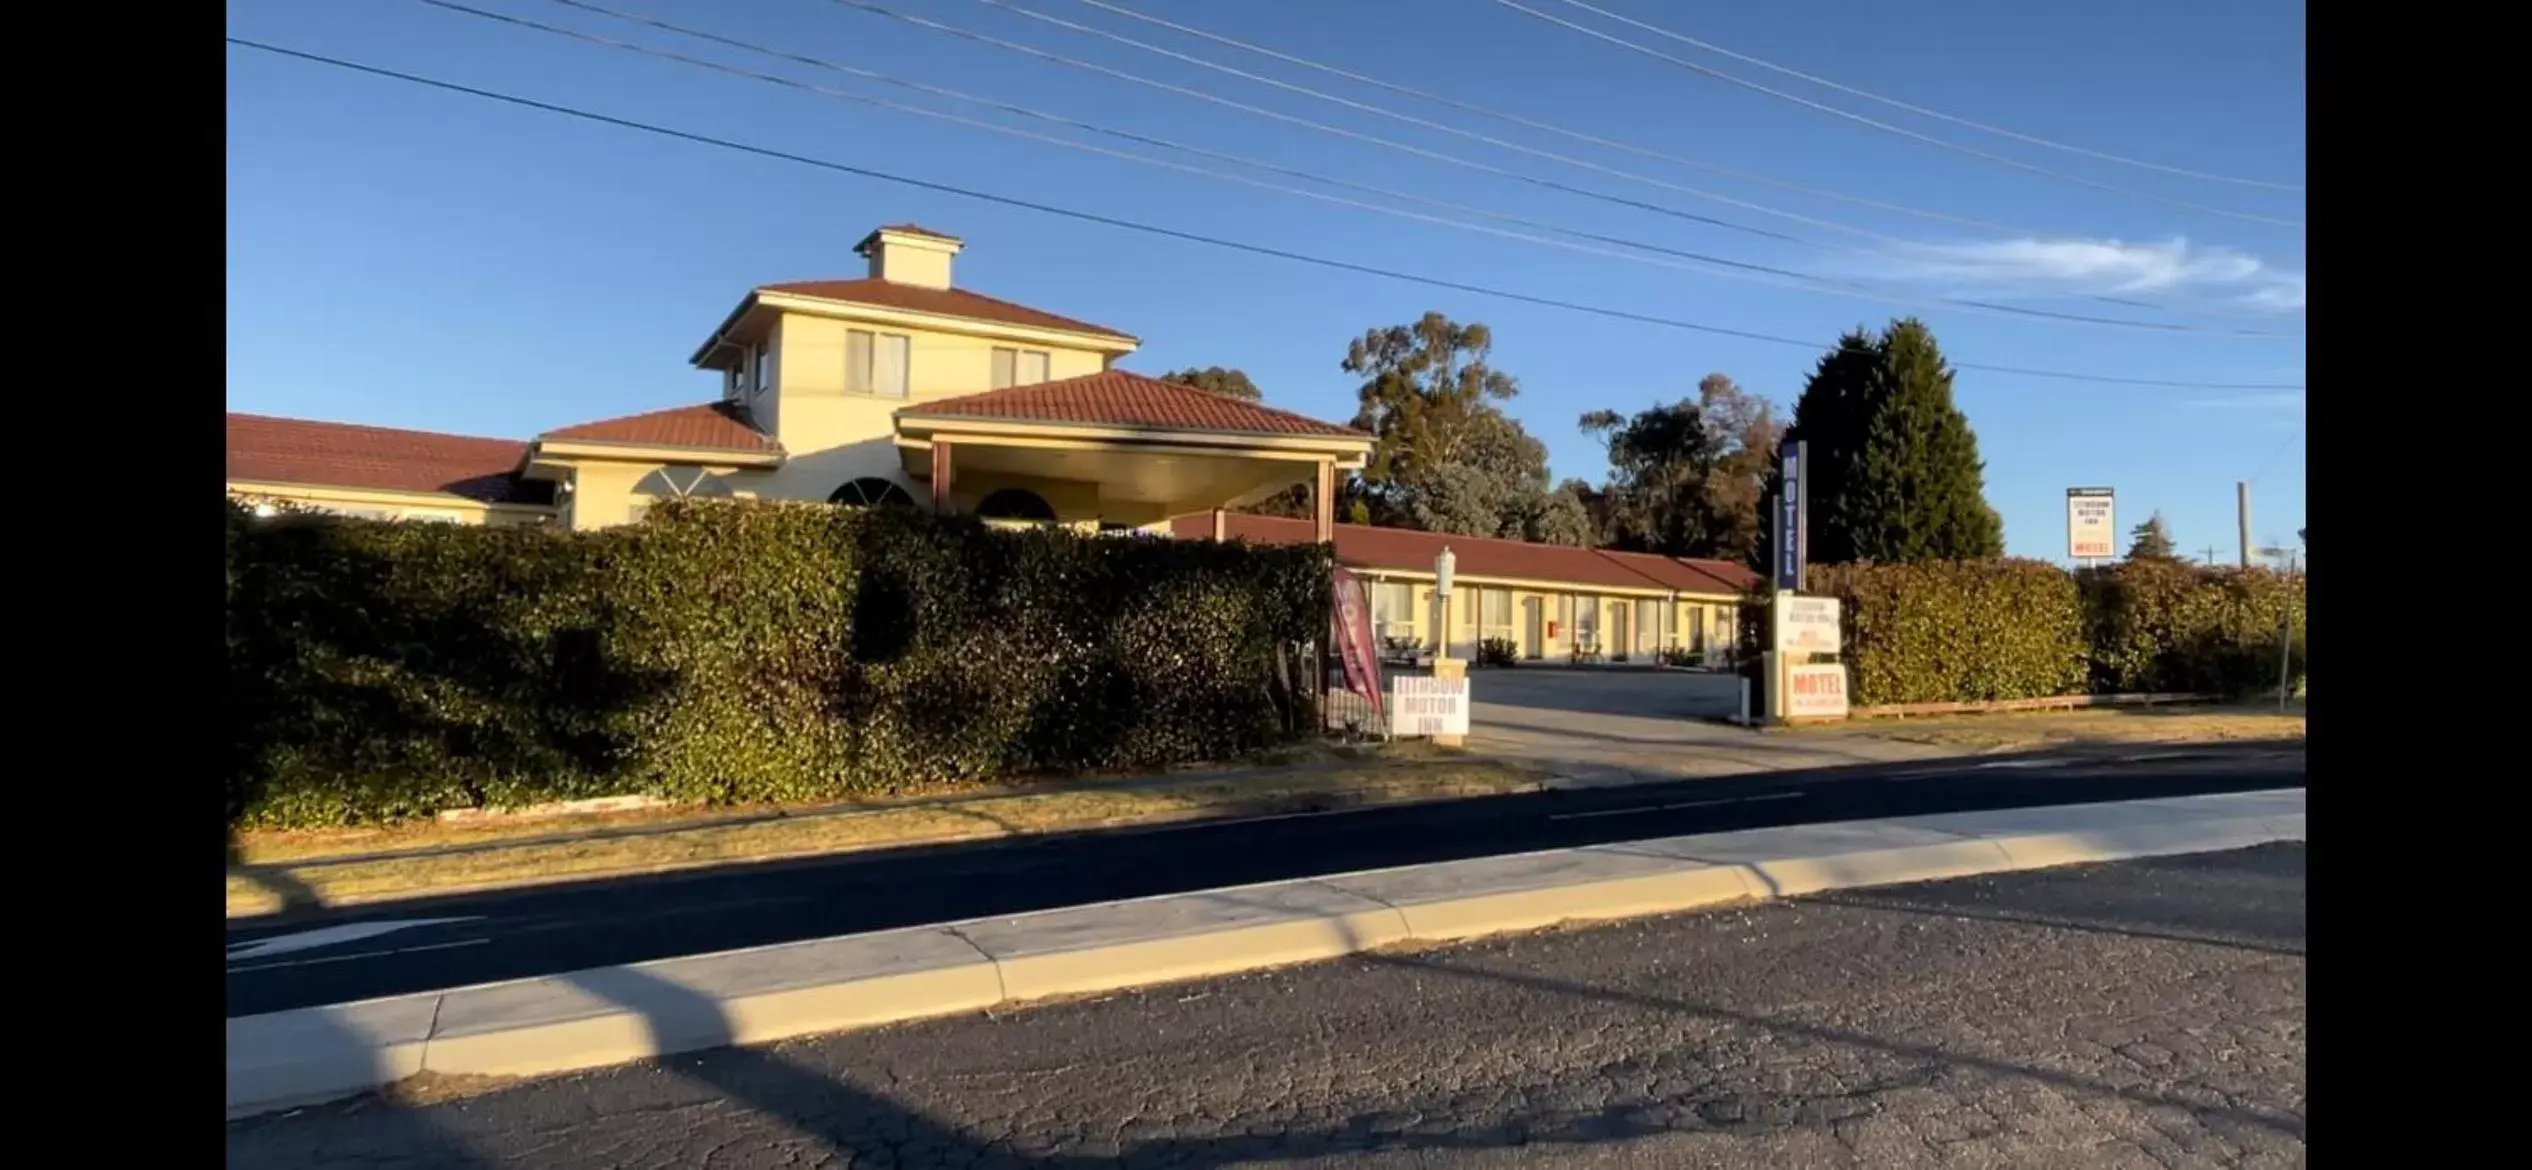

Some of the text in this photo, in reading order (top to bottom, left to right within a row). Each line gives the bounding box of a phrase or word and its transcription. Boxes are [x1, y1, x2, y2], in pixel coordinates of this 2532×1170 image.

[1783, 456, 1797, 576] MOTEL
[1793, 673, 1842, 694] MOTEL
[1405, 697, 1456, 714] MOTOR
